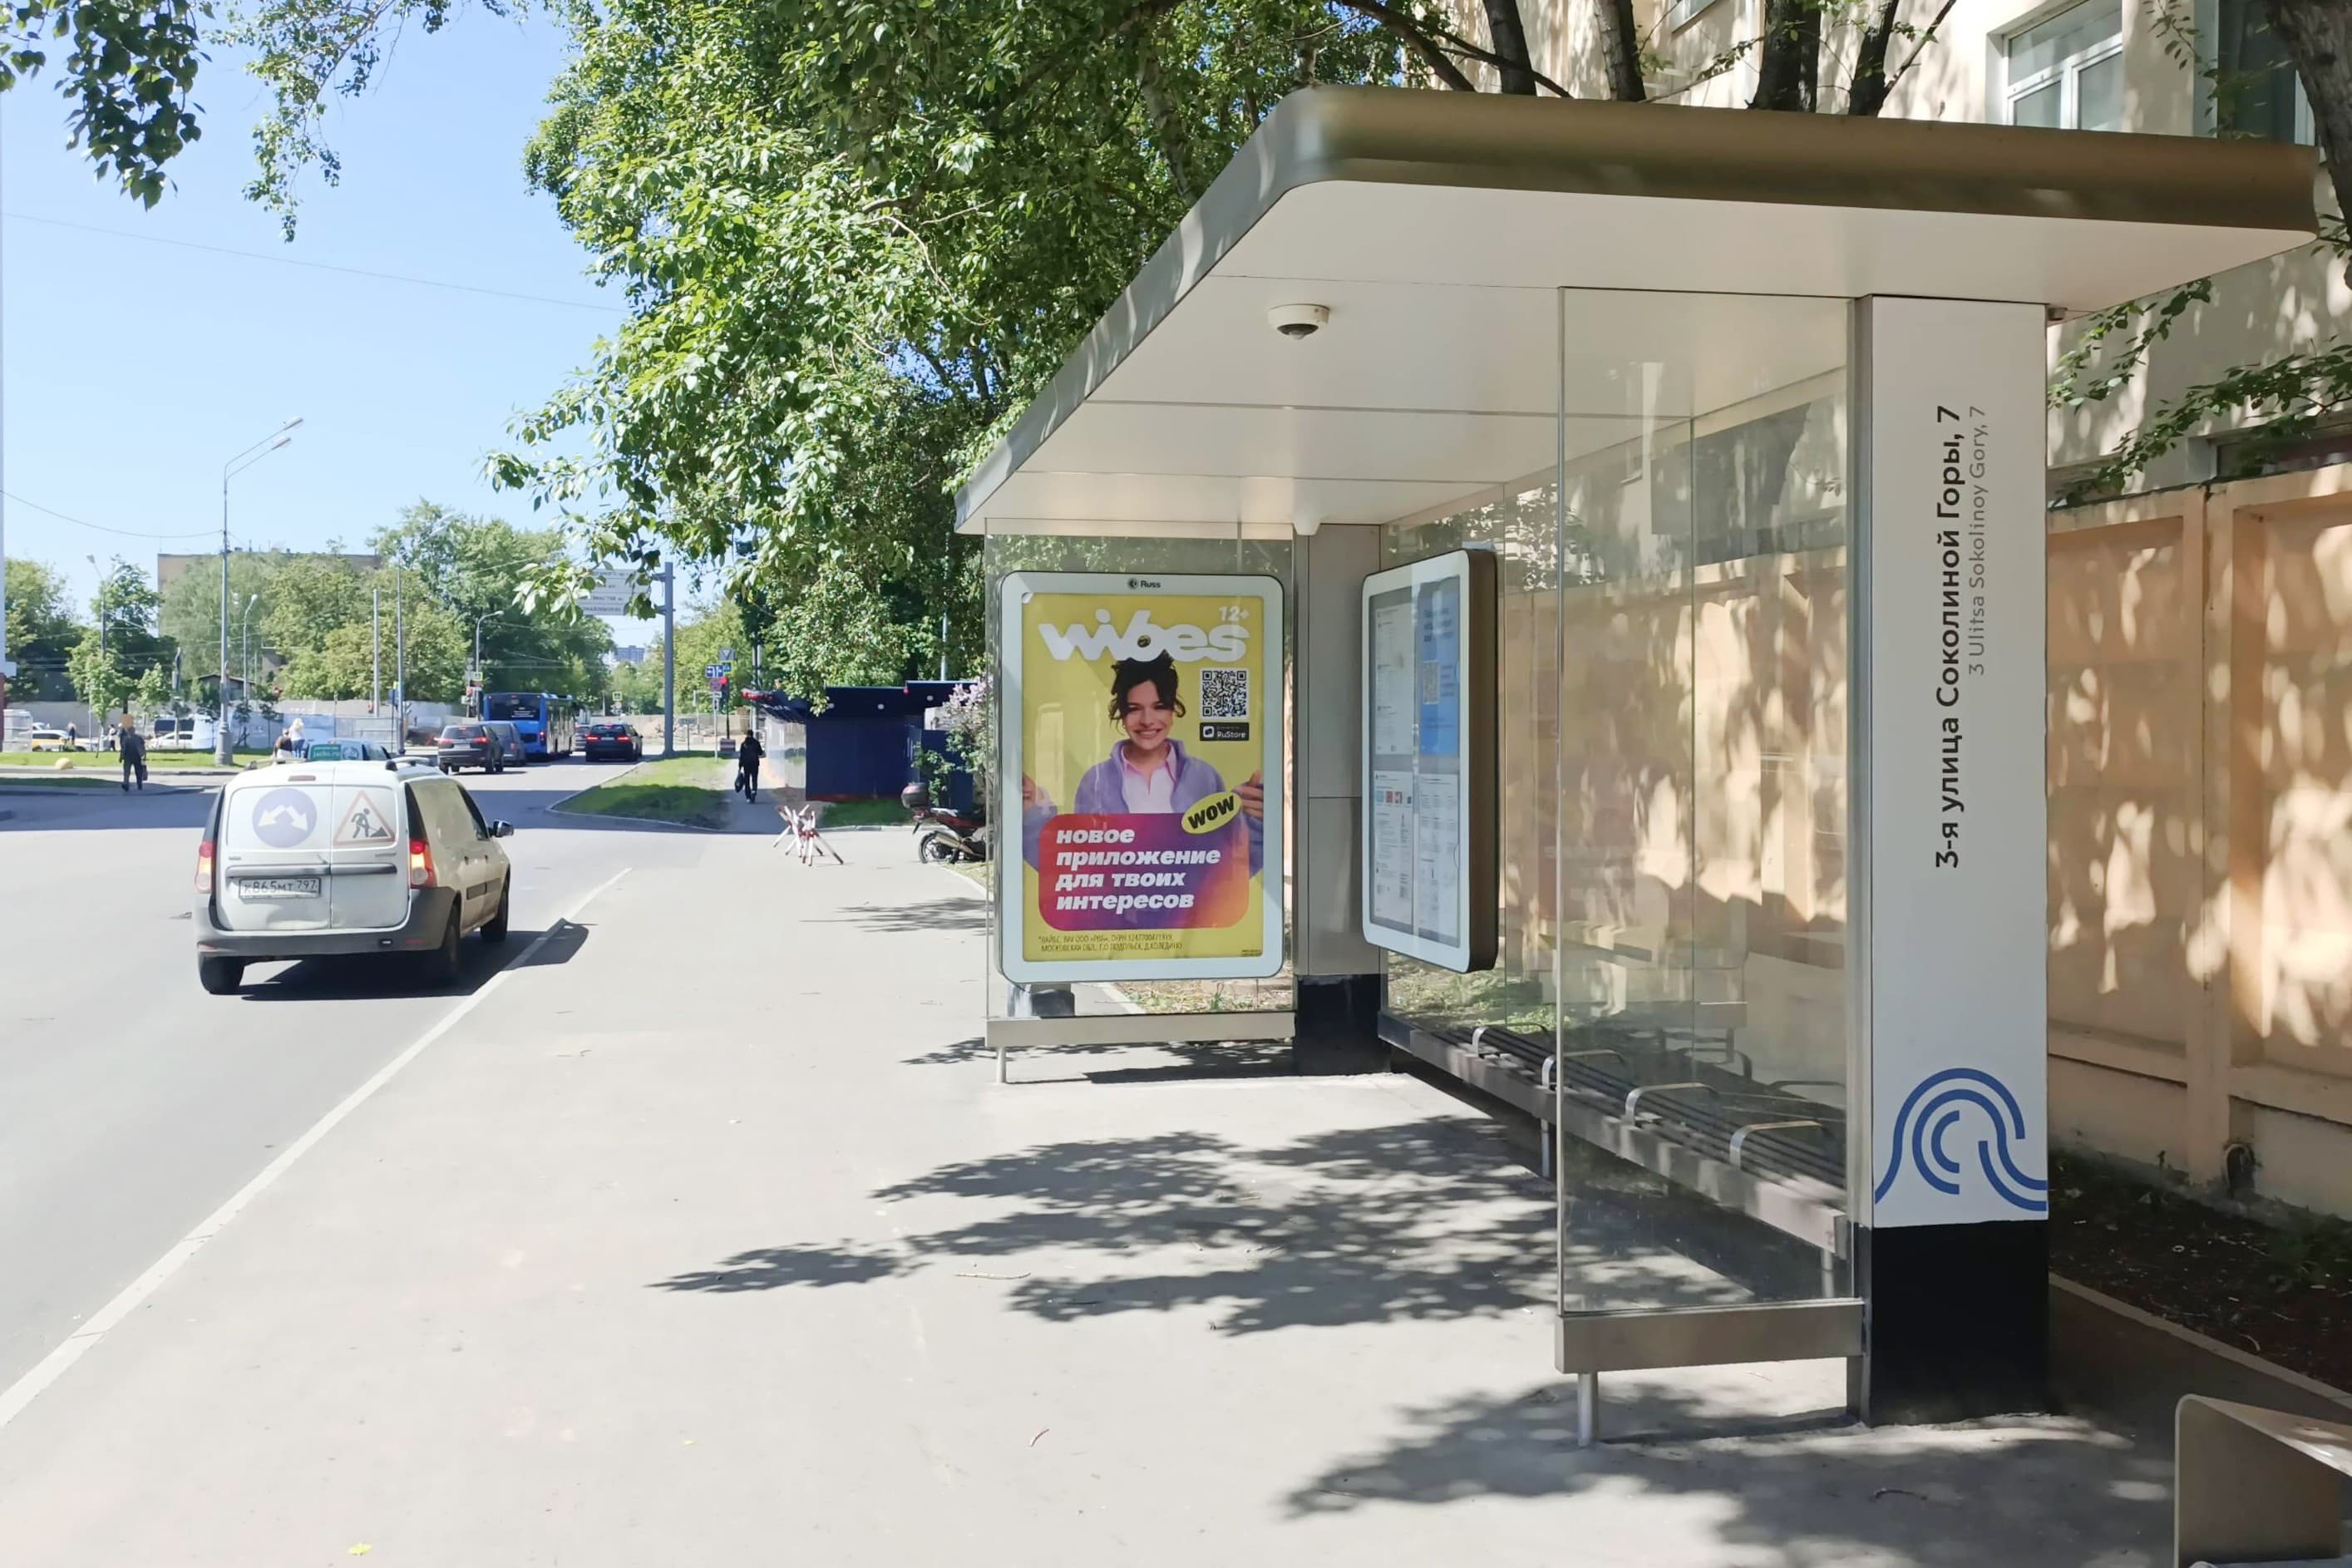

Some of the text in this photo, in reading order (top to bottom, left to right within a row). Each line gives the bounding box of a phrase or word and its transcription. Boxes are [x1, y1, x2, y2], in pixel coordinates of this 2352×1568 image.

[1968, 406, 1989, 675] 3 Ulitsa Sokolinoy Gory, 7
[1140, 579, 1161, 589] Russ
[1219, 606, 1250, 621] 12+
[1935, 405, 1965, 868] 3-я улица Соколиной Горы, 7
[1056, 829, 1135, 844] новое
[1056, 850, 1221, 871] приложение
[1055, 872, 1186, 891] для твоих
[1056, 894, 1195, 915] интересов
